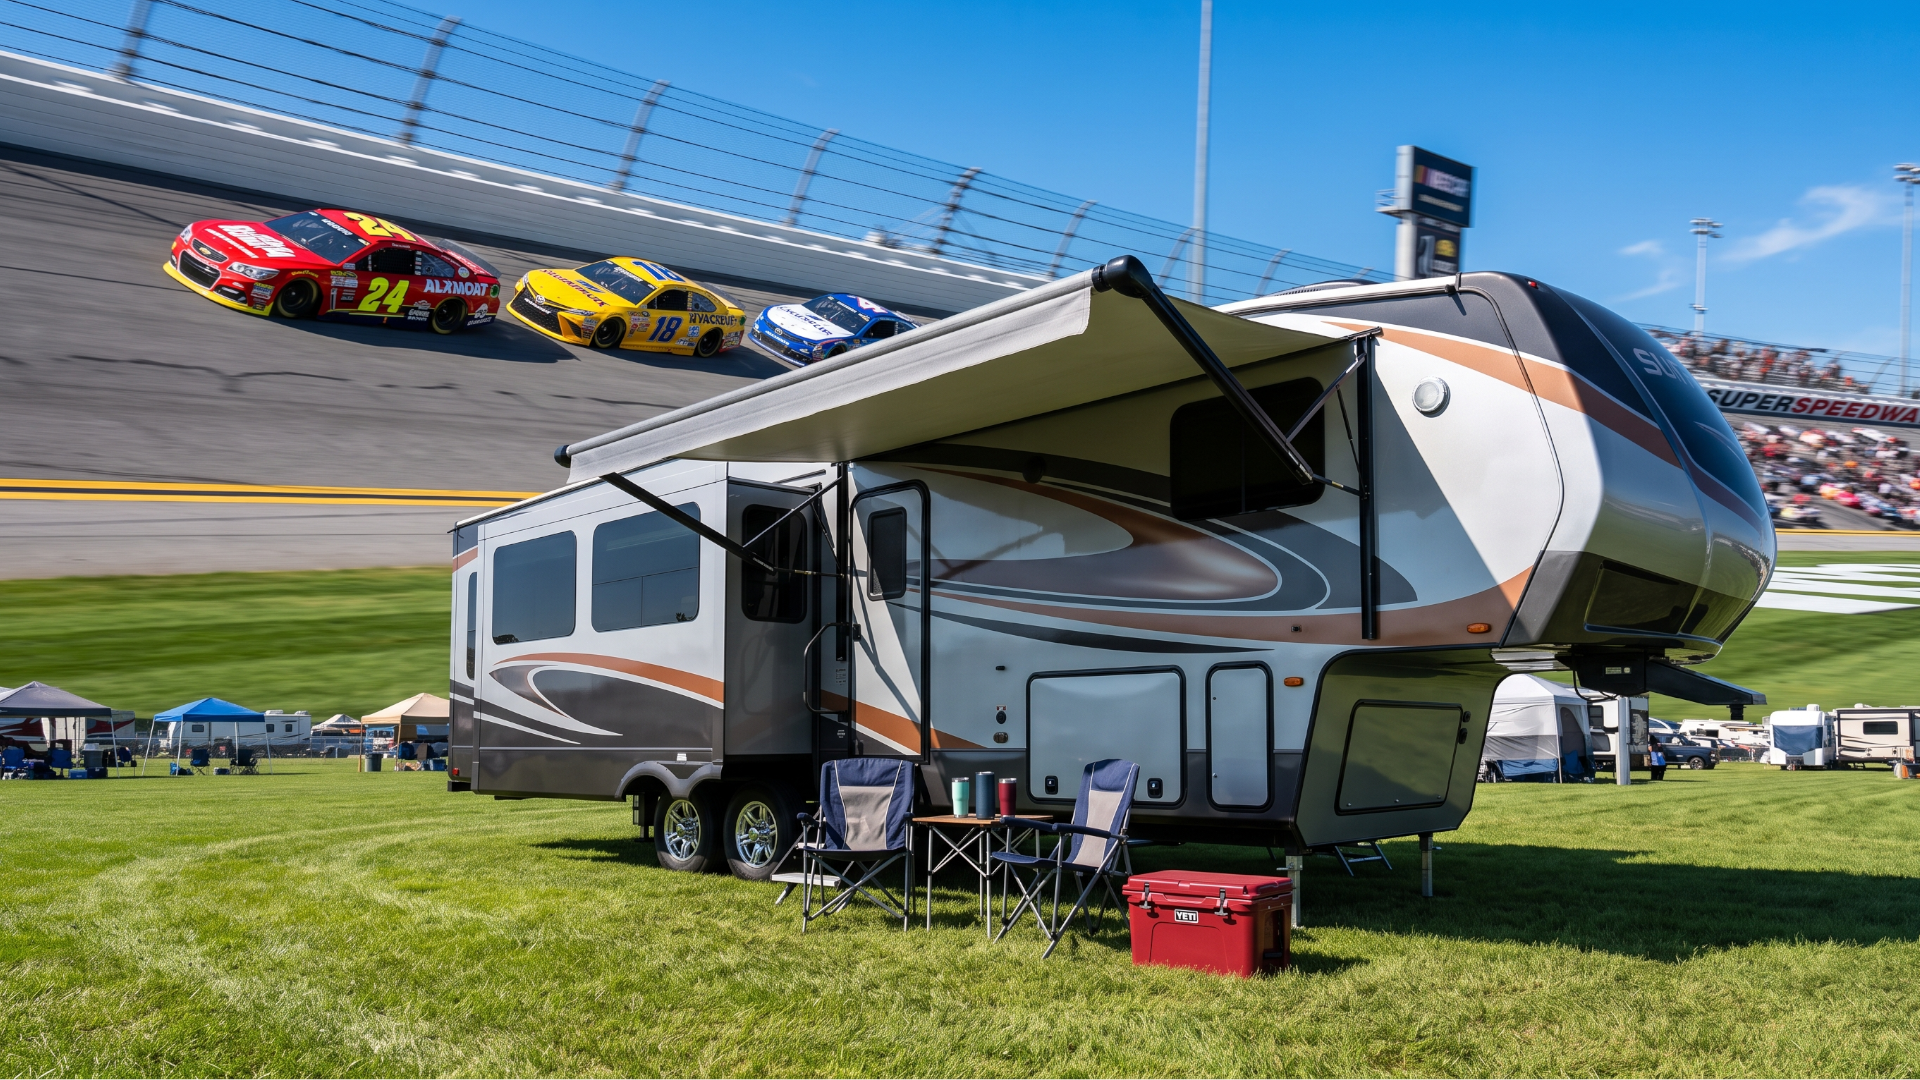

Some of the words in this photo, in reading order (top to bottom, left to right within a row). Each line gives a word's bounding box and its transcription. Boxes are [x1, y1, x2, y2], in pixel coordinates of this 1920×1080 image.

[343, 212, 417, 242] 24
[357, 276, 410, 313] 24
[646, 315, 684, 343] 18
[1707, 389, 1920, 423] SUPERSPEEDWA
[1176, 911, 1197, 921] YETI
